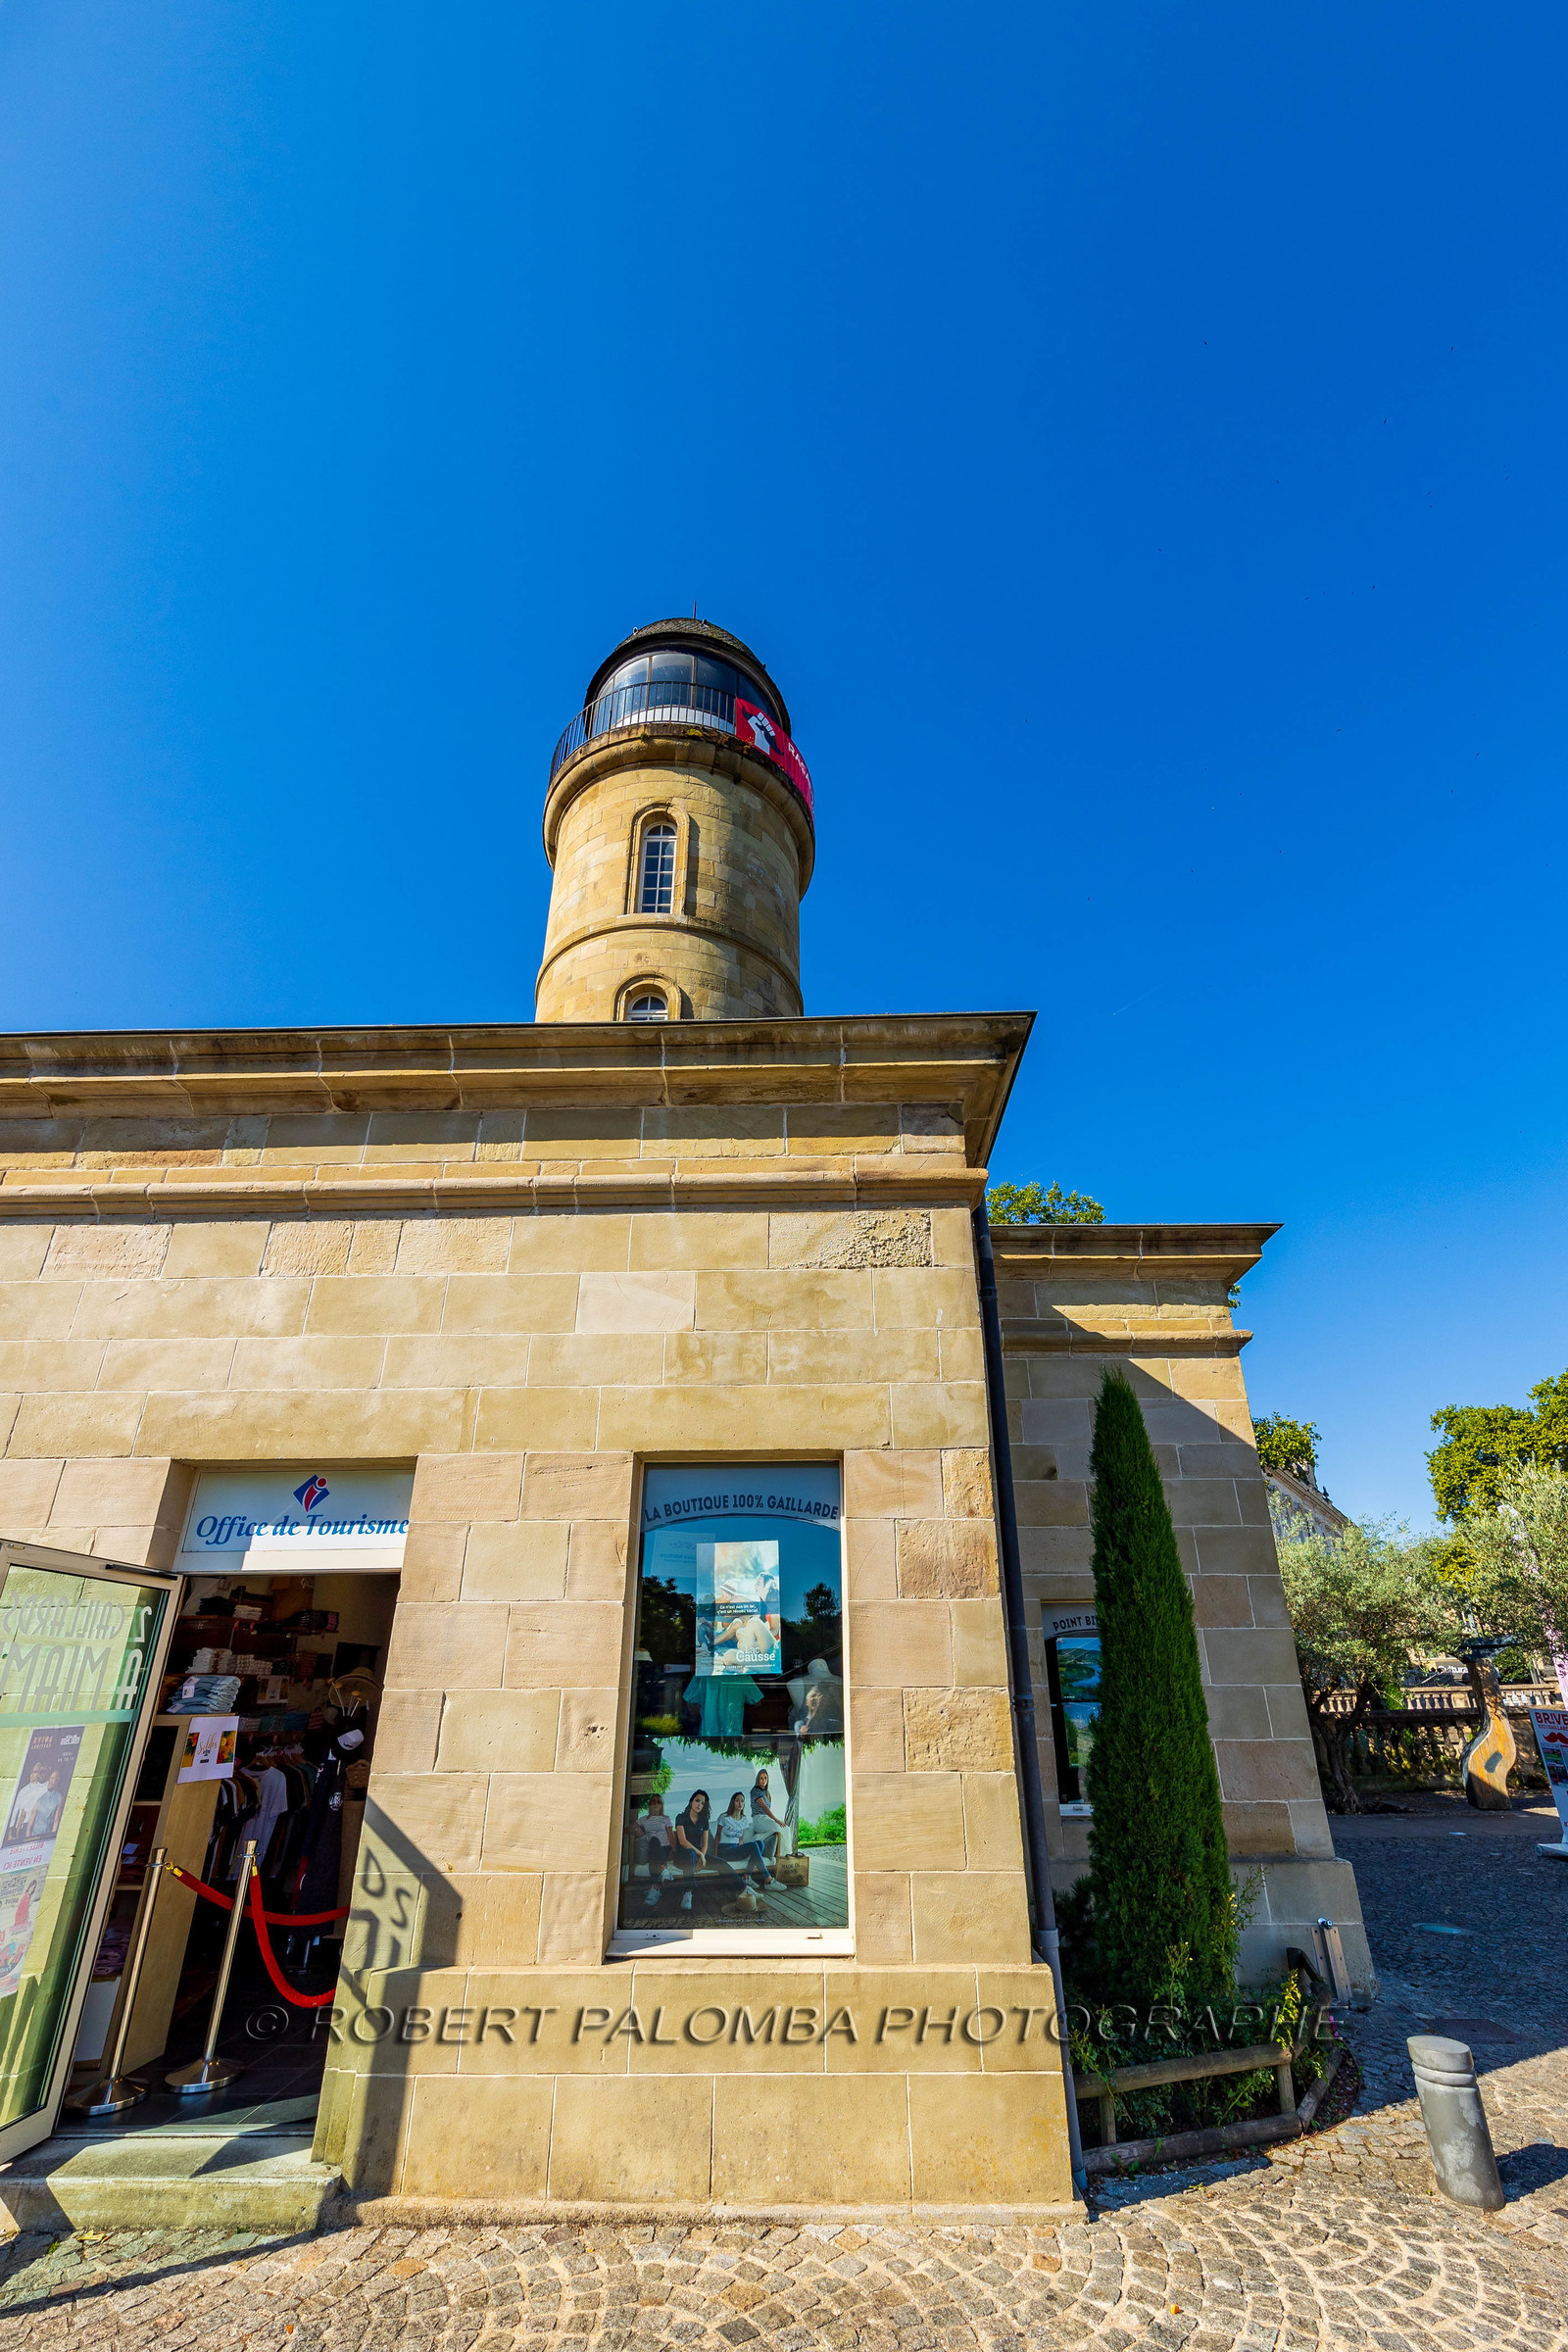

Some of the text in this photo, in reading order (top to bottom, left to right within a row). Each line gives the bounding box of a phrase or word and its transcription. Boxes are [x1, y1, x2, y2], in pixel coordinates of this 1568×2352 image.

[644, 1494, 839, 1523] LA BOUTIQUE 100% GAILLARDE
[196, 1513, 410, 1545] Office de Tourisme
[1053, 1615, 1083, 1632] POINT
[735, 1650, 776, 1662] Causse
